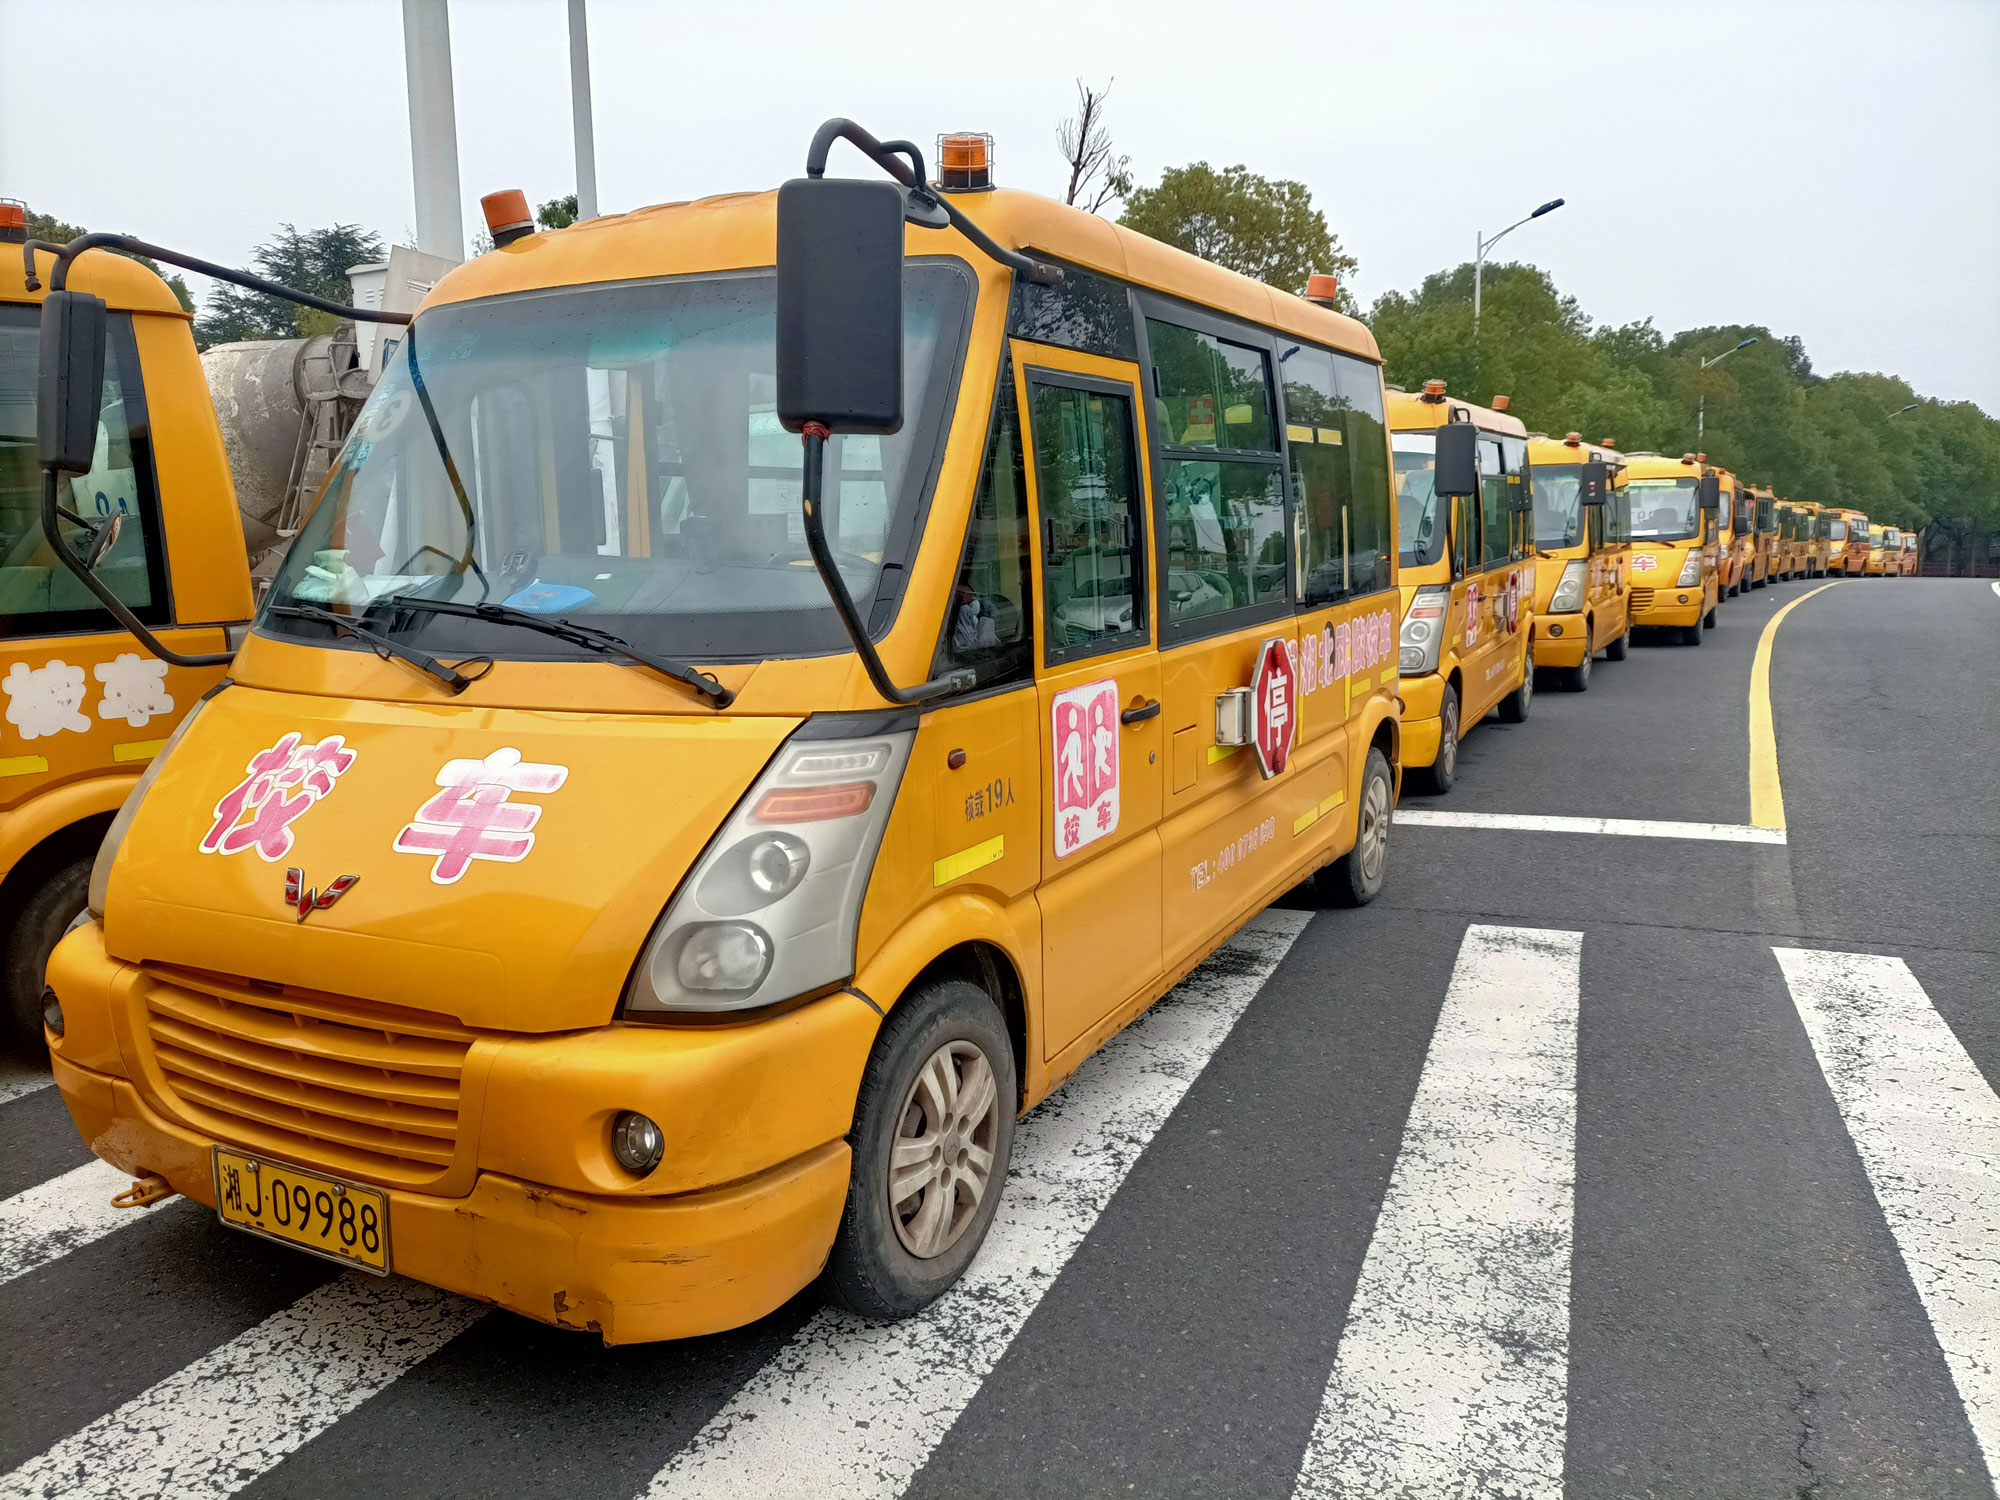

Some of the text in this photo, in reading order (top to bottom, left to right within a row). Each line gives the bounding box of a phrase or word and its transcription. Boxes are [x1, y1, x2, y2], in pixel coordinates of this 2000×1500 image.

[1264, 667, 1288, 751] 停
[199, 731, 570, 885] 校车
[1063, 800, 1112, 850] 校车
[1218, 842, 1236, 873] 400
